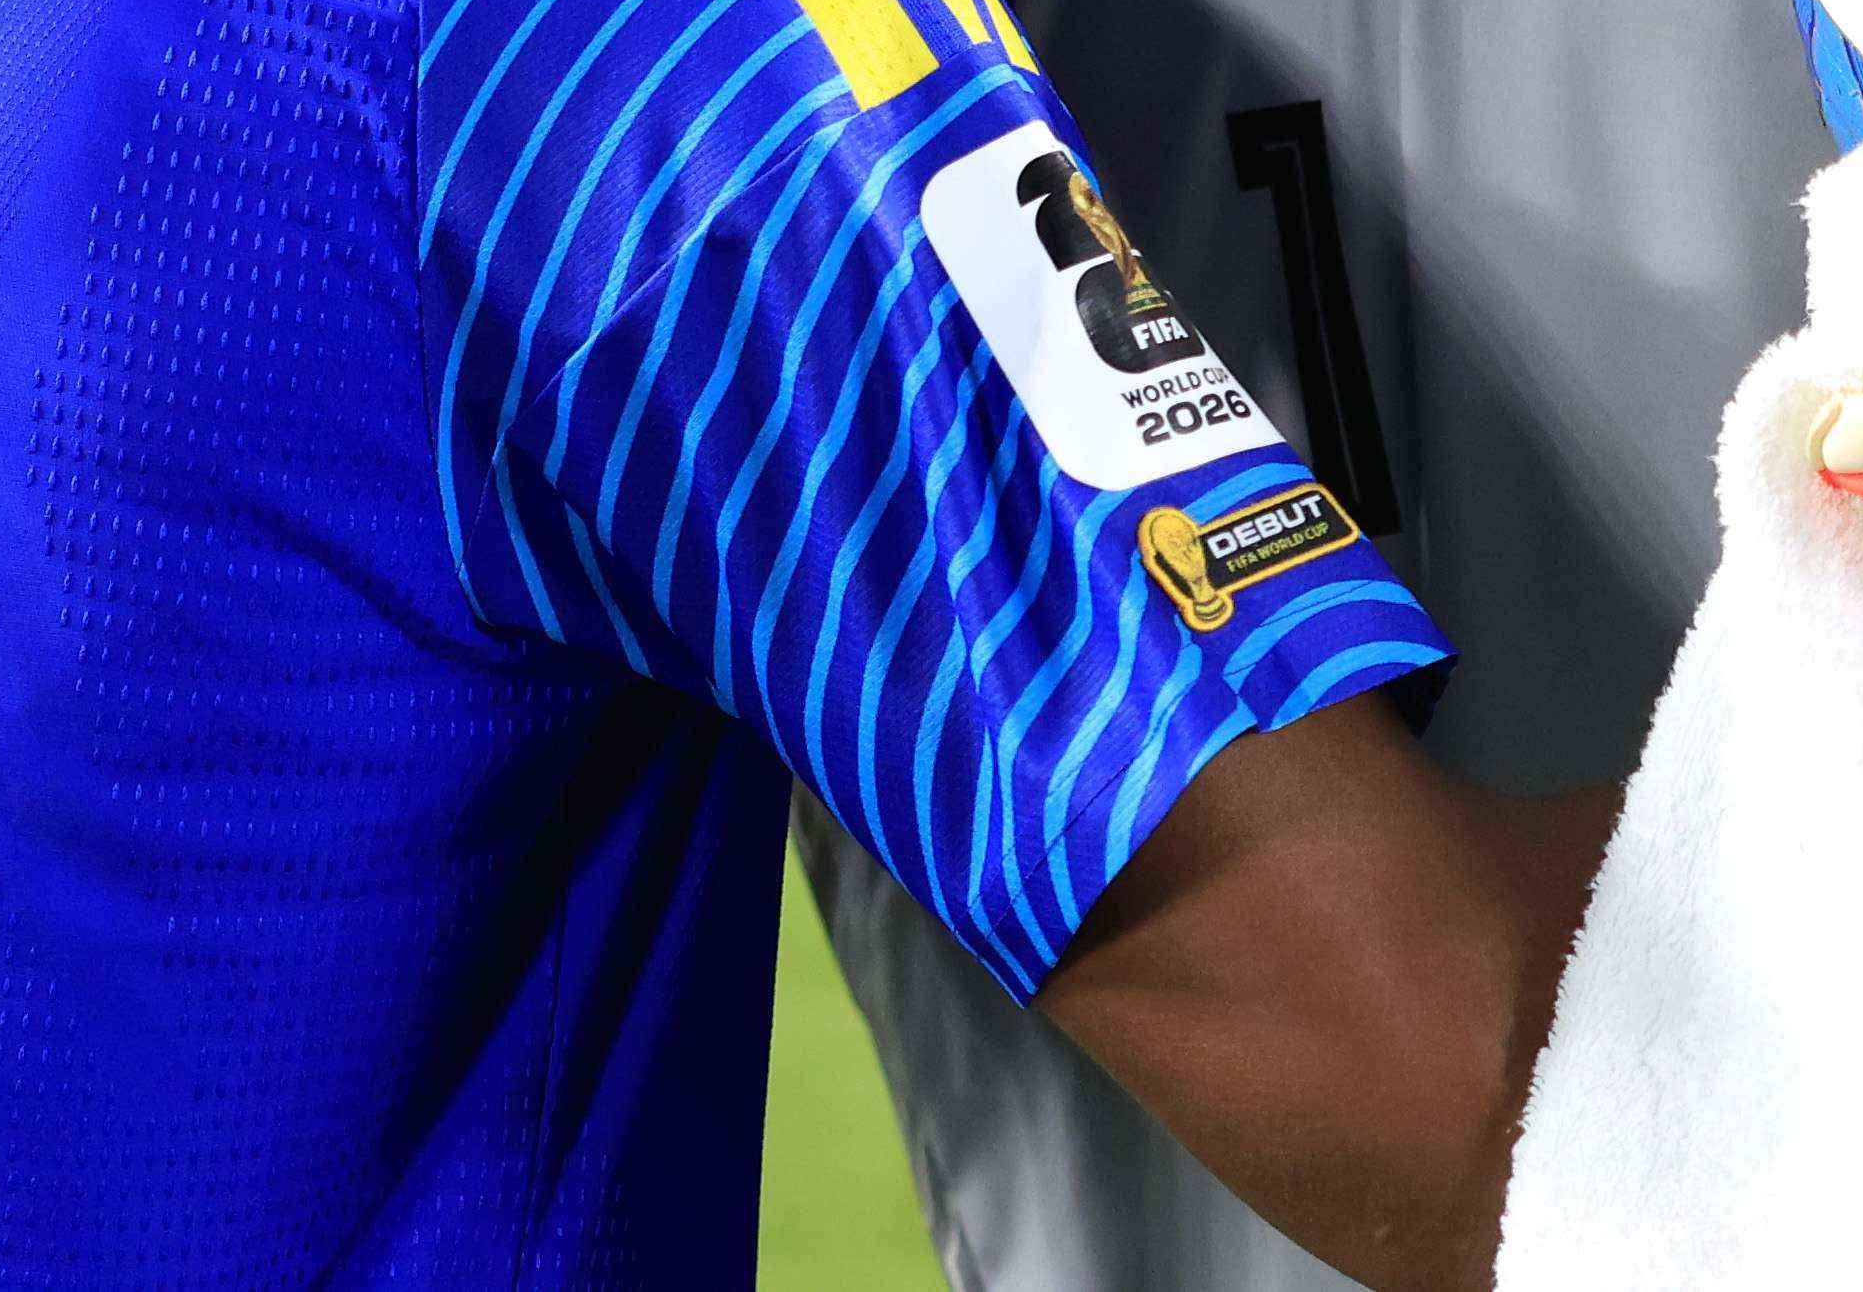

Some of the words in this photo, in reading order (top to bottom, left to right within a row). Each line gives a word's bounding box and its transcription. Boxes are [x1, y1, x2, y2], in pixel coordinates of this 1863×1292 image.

[1130, 316, 1190, 351] FIFA
[1120, 371, 1202, 409] WORLD
[1135, 389, 1252, 447] 2026
[1207, 494, 1322, 560] DEBUT
[1225, 552, 1259, 573] FIFA
[1257, 532, 1304, 560] WORLD
[1304, 520, 1331, 540] CUP
